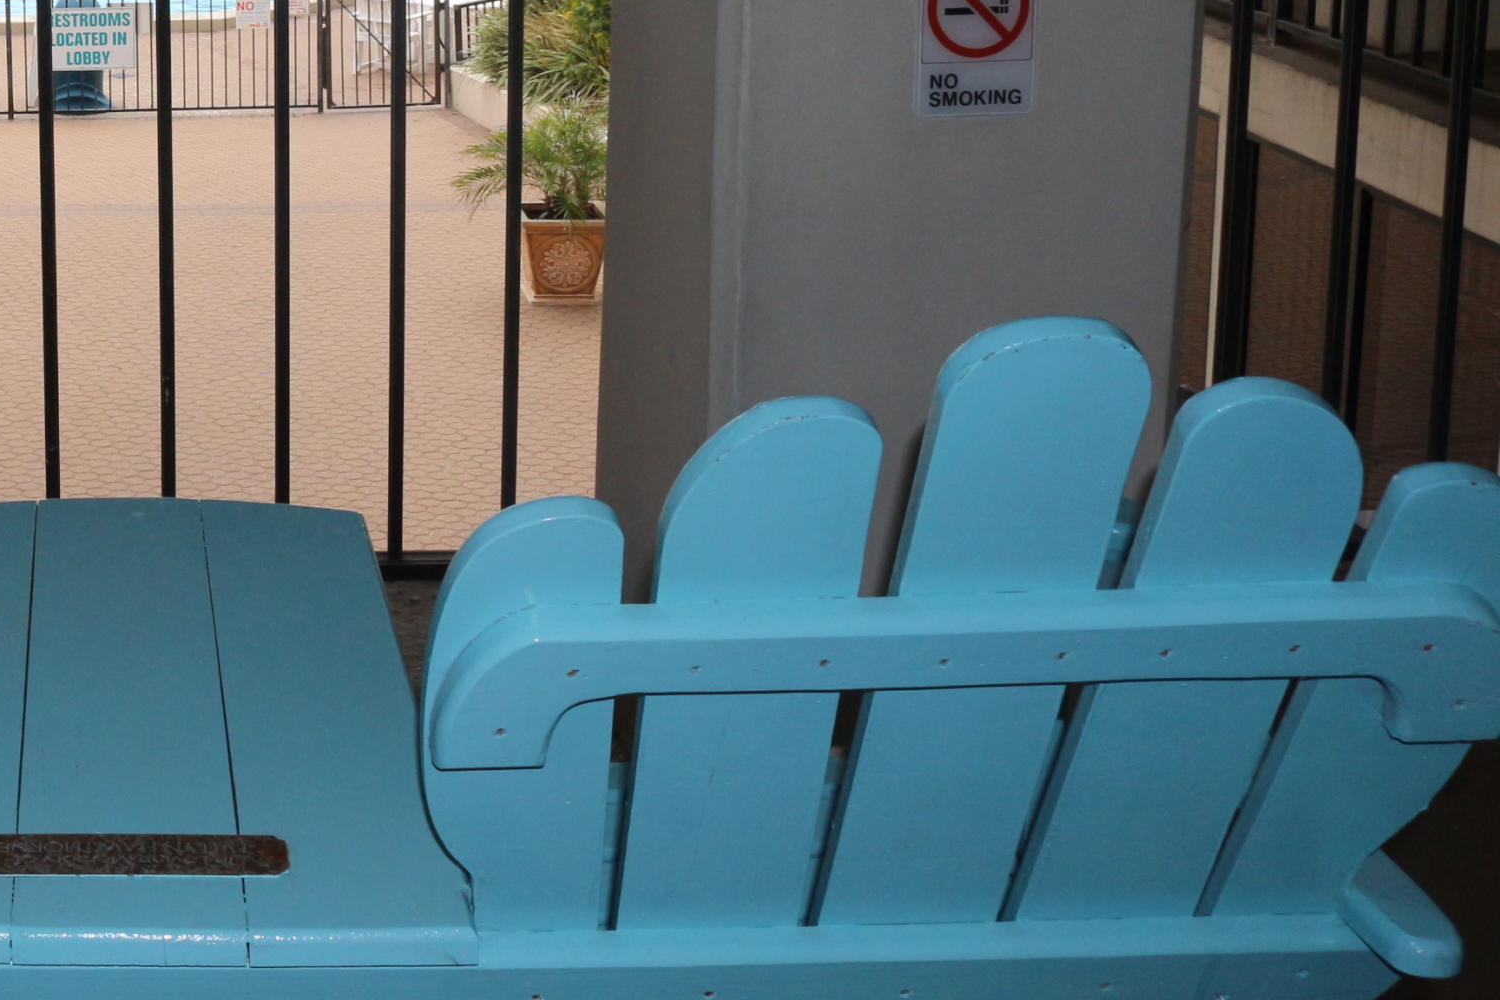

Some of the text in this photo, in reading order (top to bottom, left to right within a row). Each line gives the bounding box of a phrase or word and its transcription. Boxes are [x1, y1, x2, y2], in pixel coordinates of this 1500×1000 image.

[237, 1, 255, 11] NO
[52, 12, 131, 28] ESTROOMS
[113, 31, 127, 46] IN
[66, 51, 111, 66] LOBBY
[930, 73, 959, 89] NO
[929, 88, 1022, 107] SMOKING
